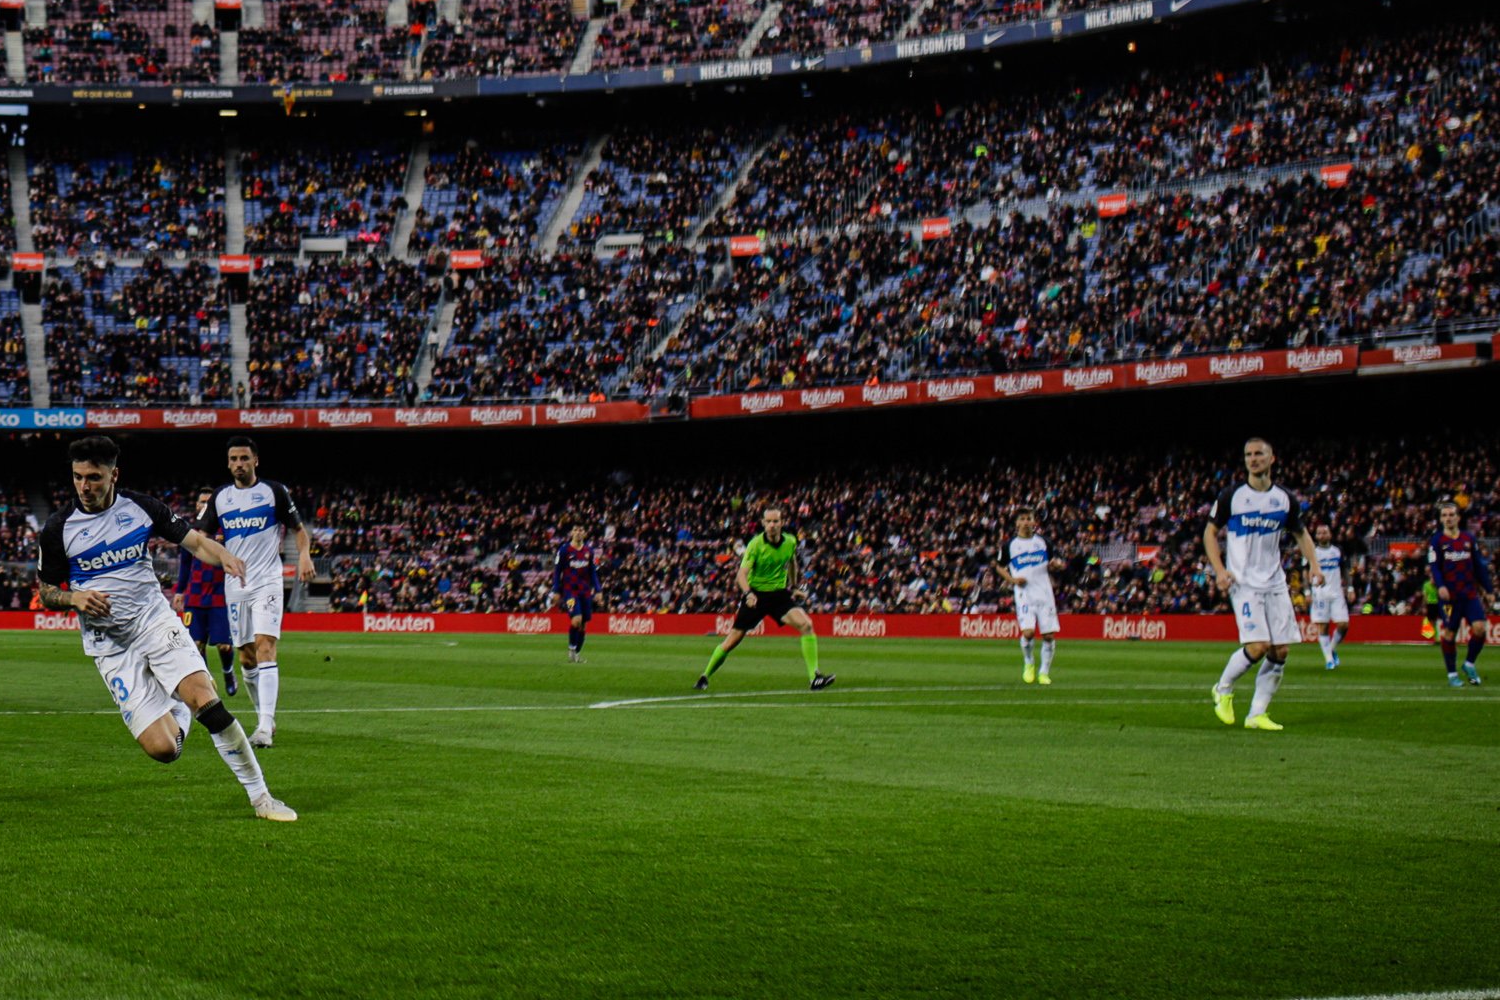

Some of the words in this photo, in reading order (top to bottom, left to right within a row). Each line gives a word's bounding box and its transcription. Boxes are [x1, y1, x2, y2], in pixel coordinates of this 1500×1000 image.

[700, 58, 772, 80] NIKE.COM/FCB
[1210, 355, 1264, 375] Rakuten
[1287, 348, 1343, 370] Rakuten
[1063, 366, 1113, 388] Rakuten
[1135, 361, 1187, 382] Rakuten
[927, 378, 974, 398] Rakuten
[994, 373, 1043, 393] Rakuten
[801, 388, 844, 406] Rakuten
[862, 383, 907, 402] Rakuten
[741, 393, 783, 411] Rakuten
[34, 411, 84, 427] beko
[87, 412, 140, 425] Rakuten
[163, 411, 217, 425] Rakuten
[240, 411, 293, 425] Rakuten
[318, 409, 372, 424] Rakuten
[470, 408, 522, 422] Rakuten
[546, 405, 596, 421] Rakuten
[222, 516, 267, 529] betway
[1241, 516, 1280, 530] betway
[77, 541, 145, 572] betway
[1243, 602, 1251, 618] 4
[35, 613, 80, 630] Raku
[364, 615, 434, 632] Rakuten
[507, 615, 551, 632] Rakuten
[609, 615, 654, 633] Rakuten
[833, 616, 886, 637] Rakuten
[960, 616, 1019, 638] Rakuten
[1103, 616, 1166, 640] Rakuten
[111, 677, 128, 701] 3
